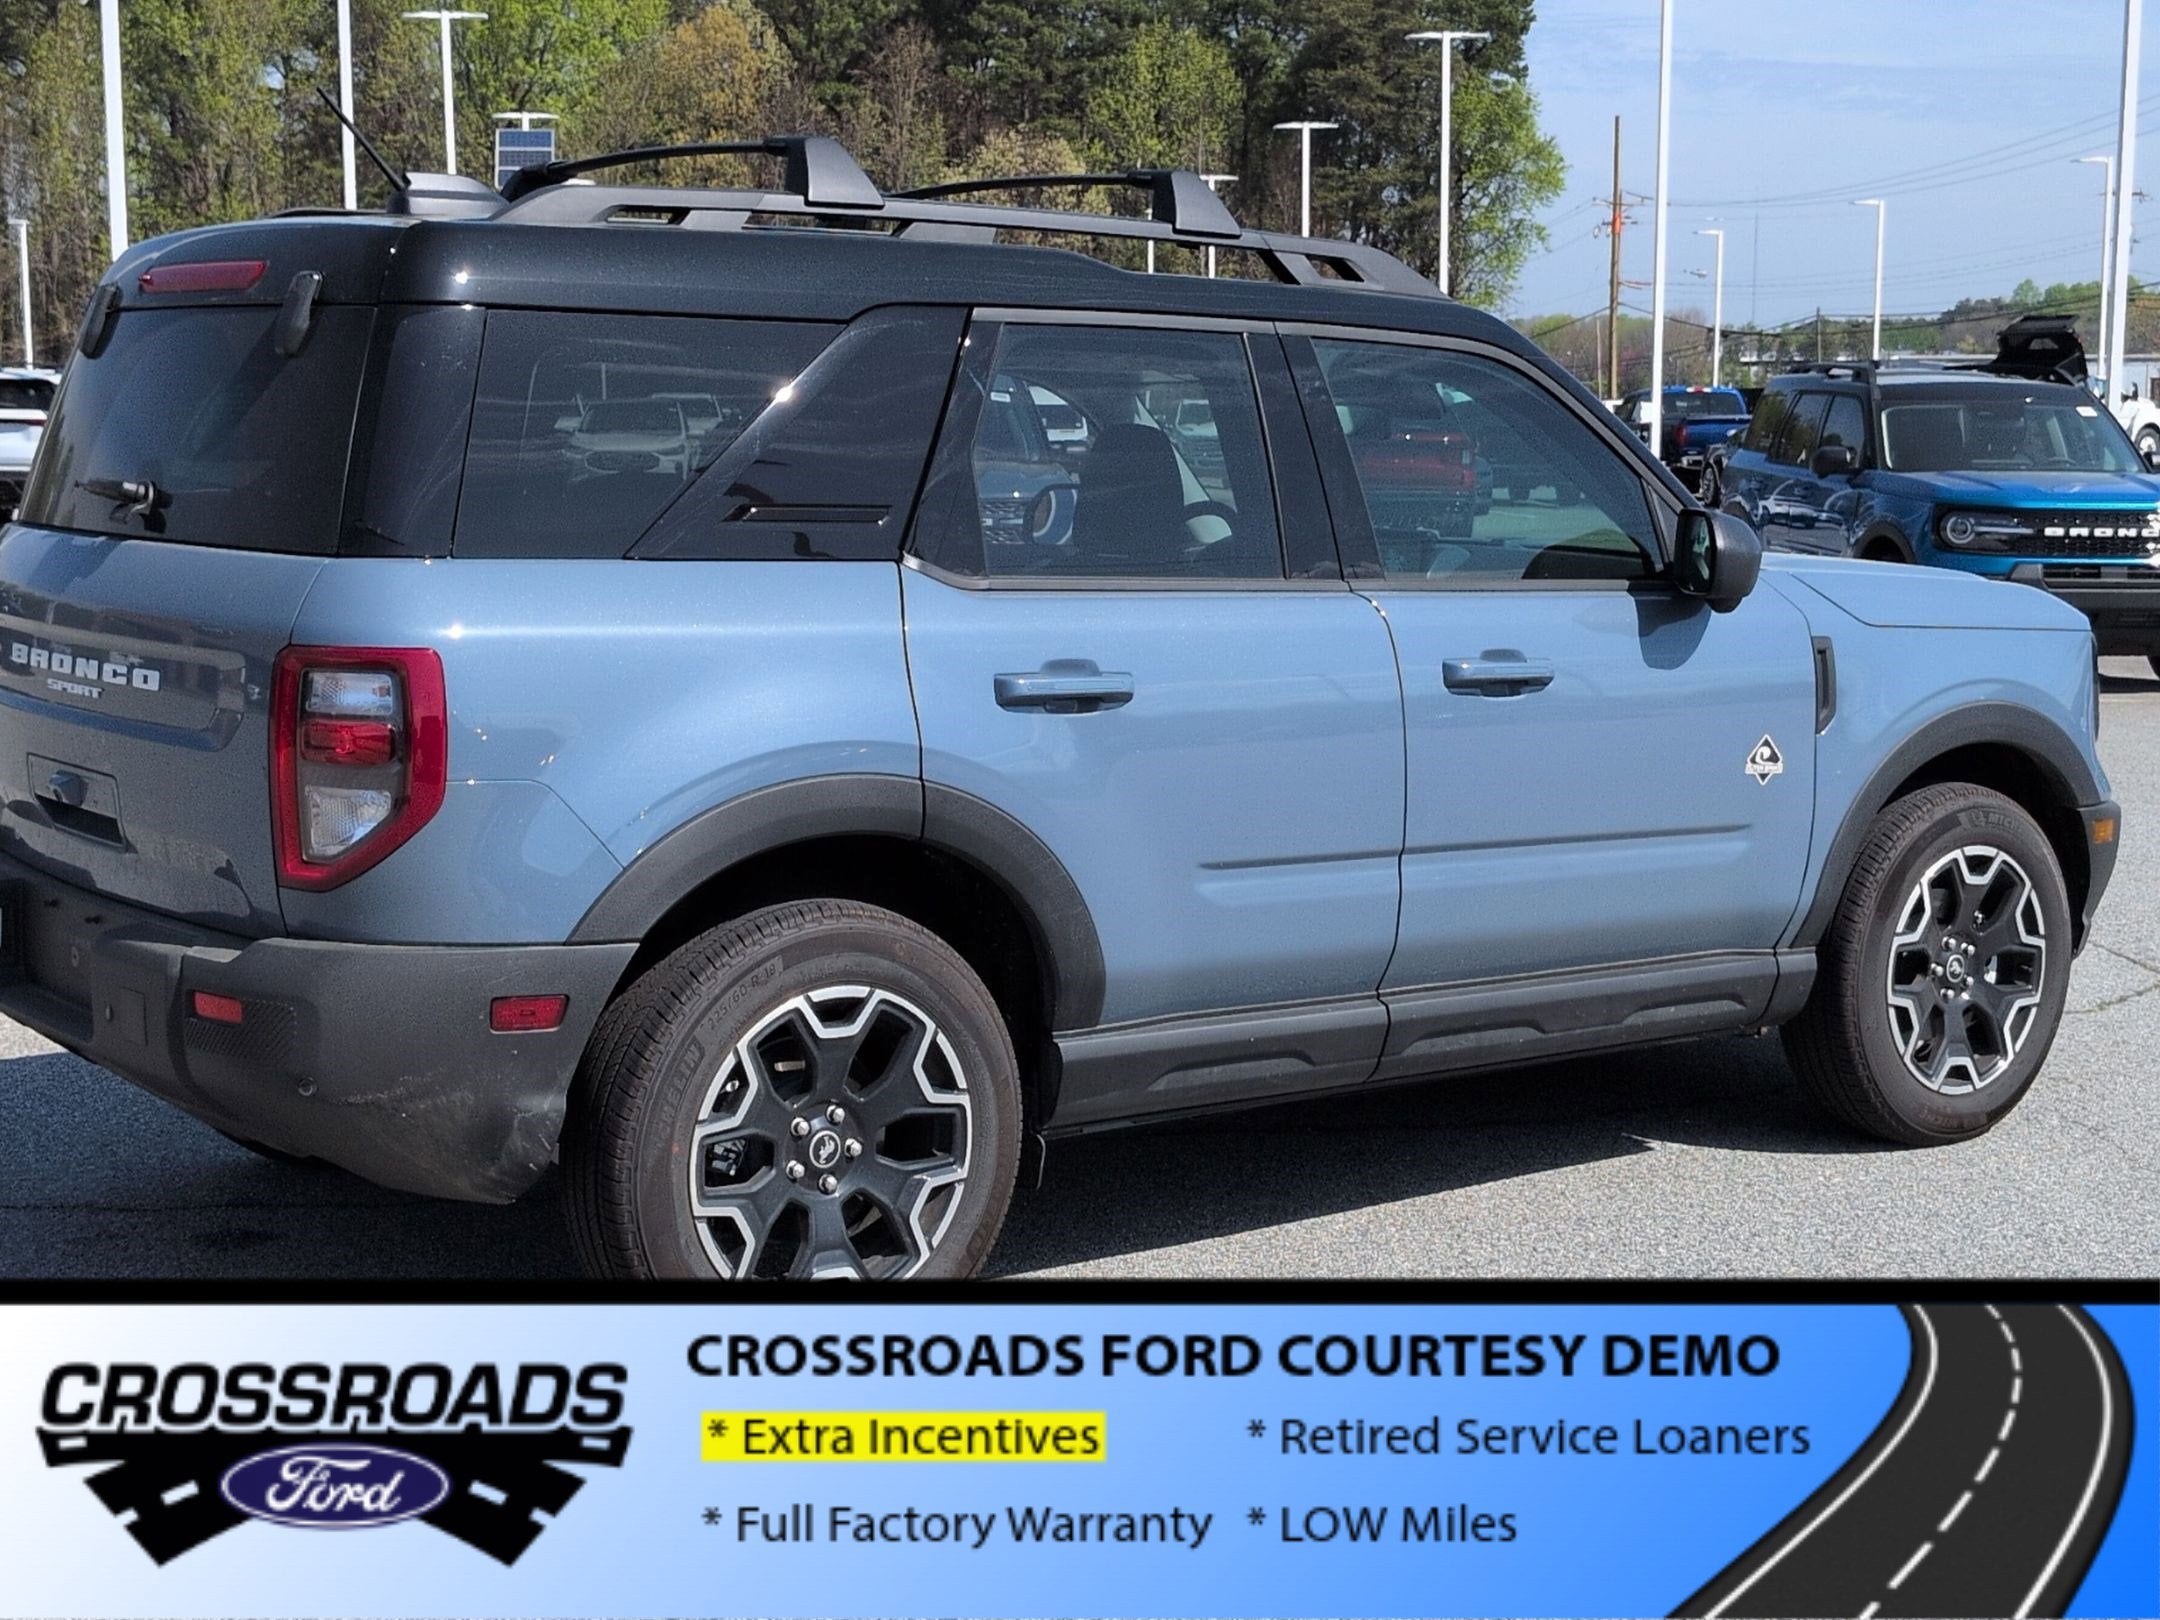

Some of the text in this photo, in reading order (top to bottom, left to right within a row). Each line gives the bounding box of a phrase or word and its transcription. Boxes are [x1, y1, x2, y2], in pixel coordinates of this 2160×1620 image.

[11, 642, 160, 692] BRONCO
[47, 678, 103, 699] SPORT
[707, 984, 749, 1030] 225/60
